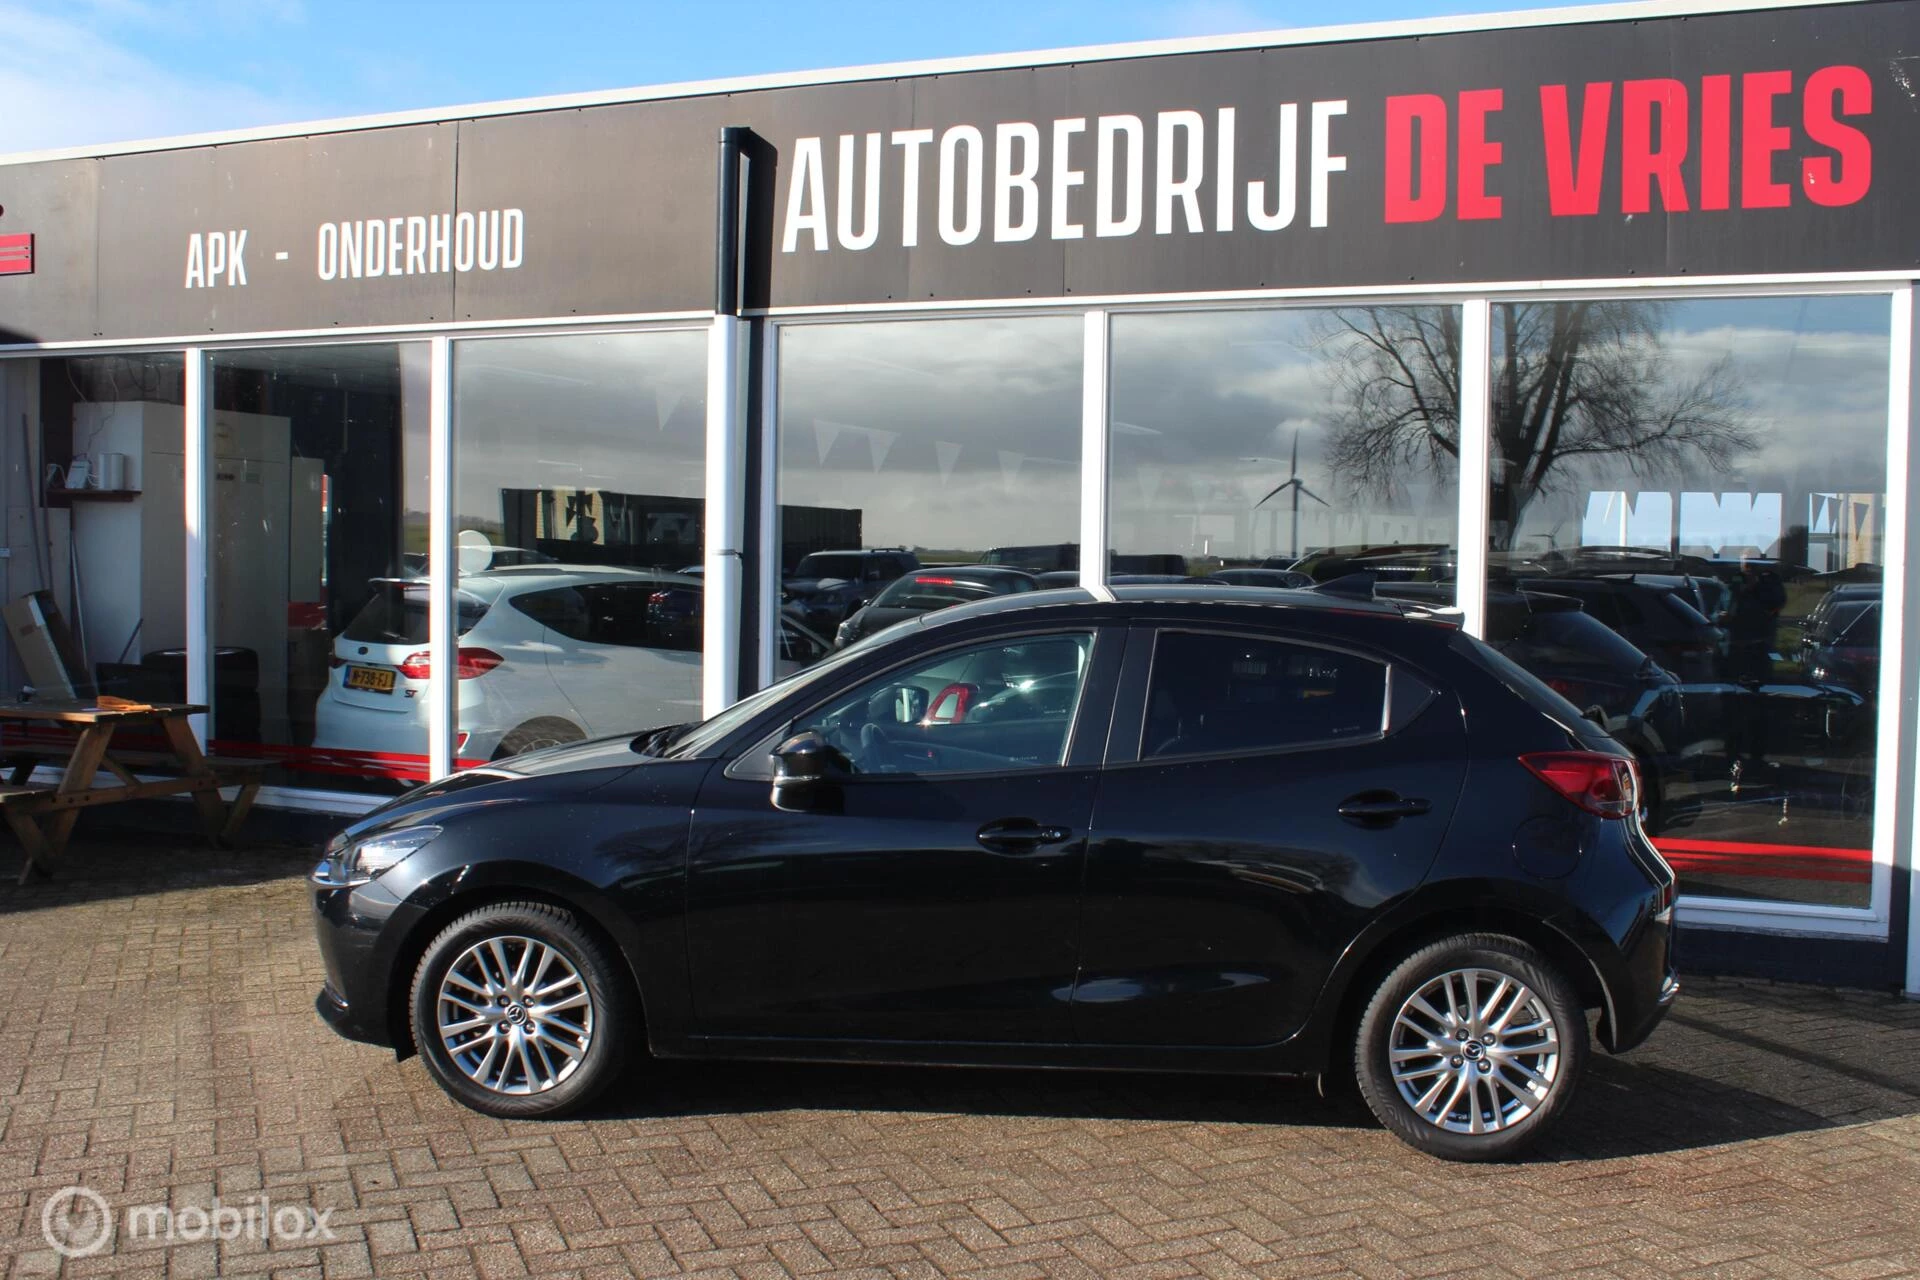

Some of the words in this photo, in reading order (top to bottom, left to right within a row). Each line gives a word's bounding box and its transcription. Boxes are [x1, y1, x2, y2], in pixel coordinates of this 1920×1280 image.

[782, 99, 1348, 253] AUTOBEDRIJF
[1384, 88, 1504, 224] DE
[1539, 64, 1873, 217] VRIES
[184, 229, 248, 289] APK
[317, 207, 525, 281] ONDERHOUD
